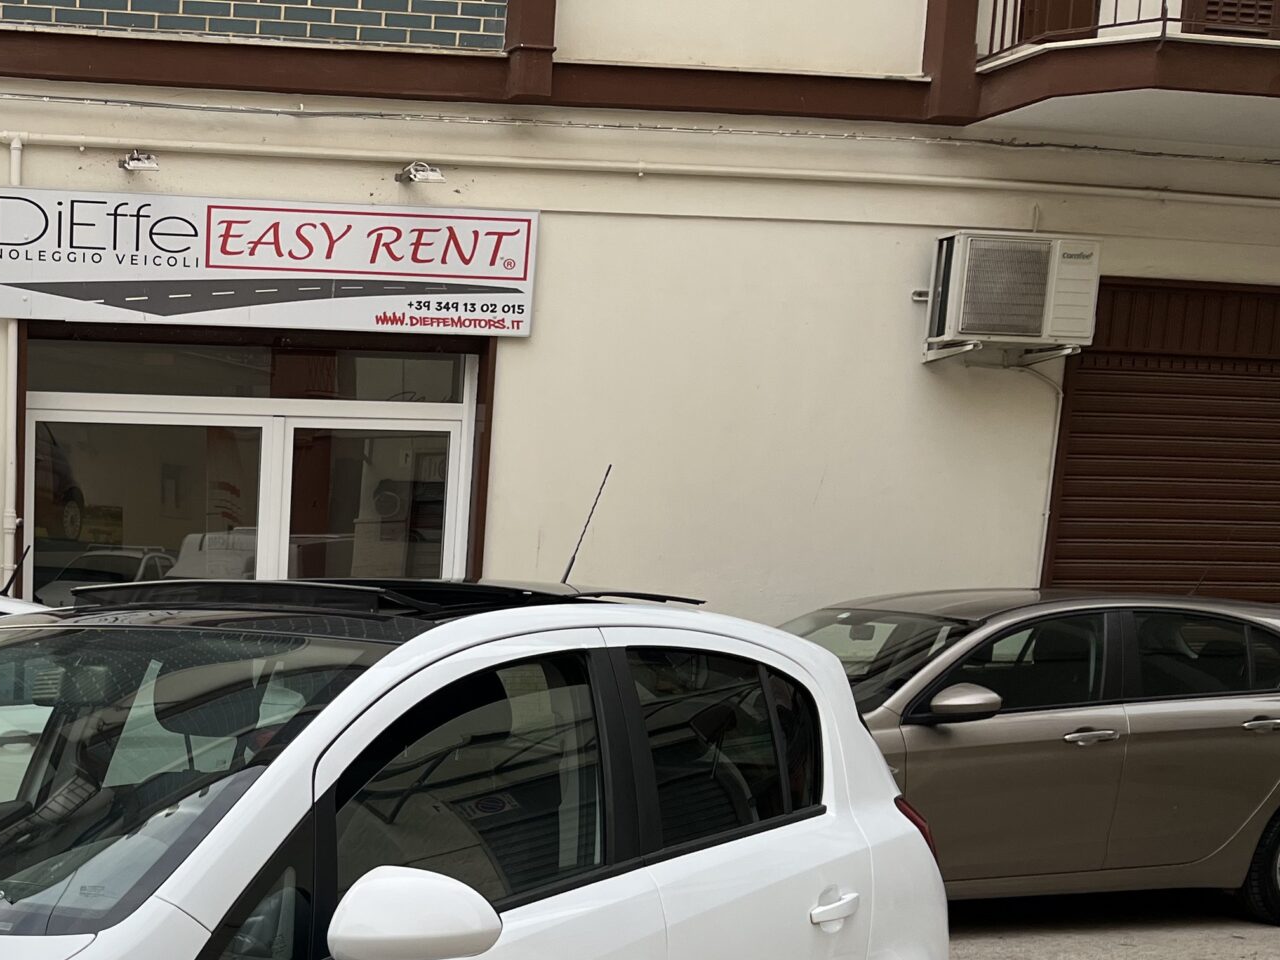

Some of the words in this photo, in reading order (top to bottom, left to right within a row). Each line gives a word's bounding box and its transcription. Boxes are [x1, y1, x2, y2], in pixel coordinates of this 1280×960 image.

[217, 220, 352, 260] EASY
[116, 253, 199, 268] VEICOLI
[407, 300, 430, 311] +39
[435, 301, 458, 312] 349
[463, 302, 476, 313] 13
[481, 303, 497, 313] 02
[501, 304, 525, 315] 015
